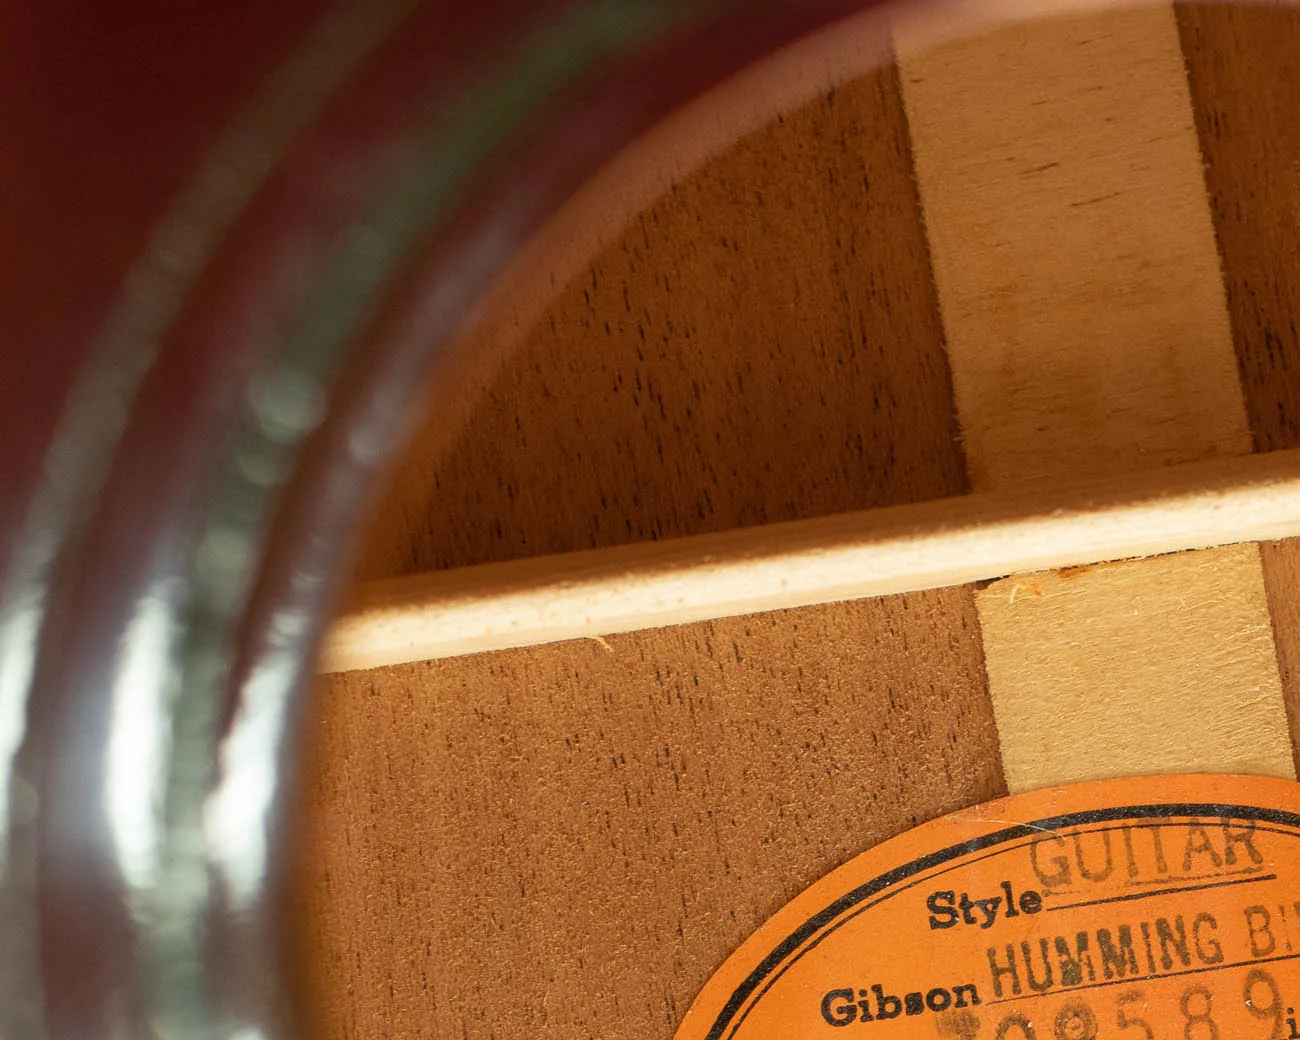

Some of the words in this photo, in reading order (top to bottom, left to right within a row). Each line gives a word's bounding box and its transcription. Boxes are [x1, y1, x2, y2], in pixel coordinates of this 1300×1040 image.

[927, 882, 1045, 929] Style
[1029, 817, 1265, 886] GUITAR
[820, 980, 980, 1028] Gibson
[985, 911, 1226, 998] HUMMING
